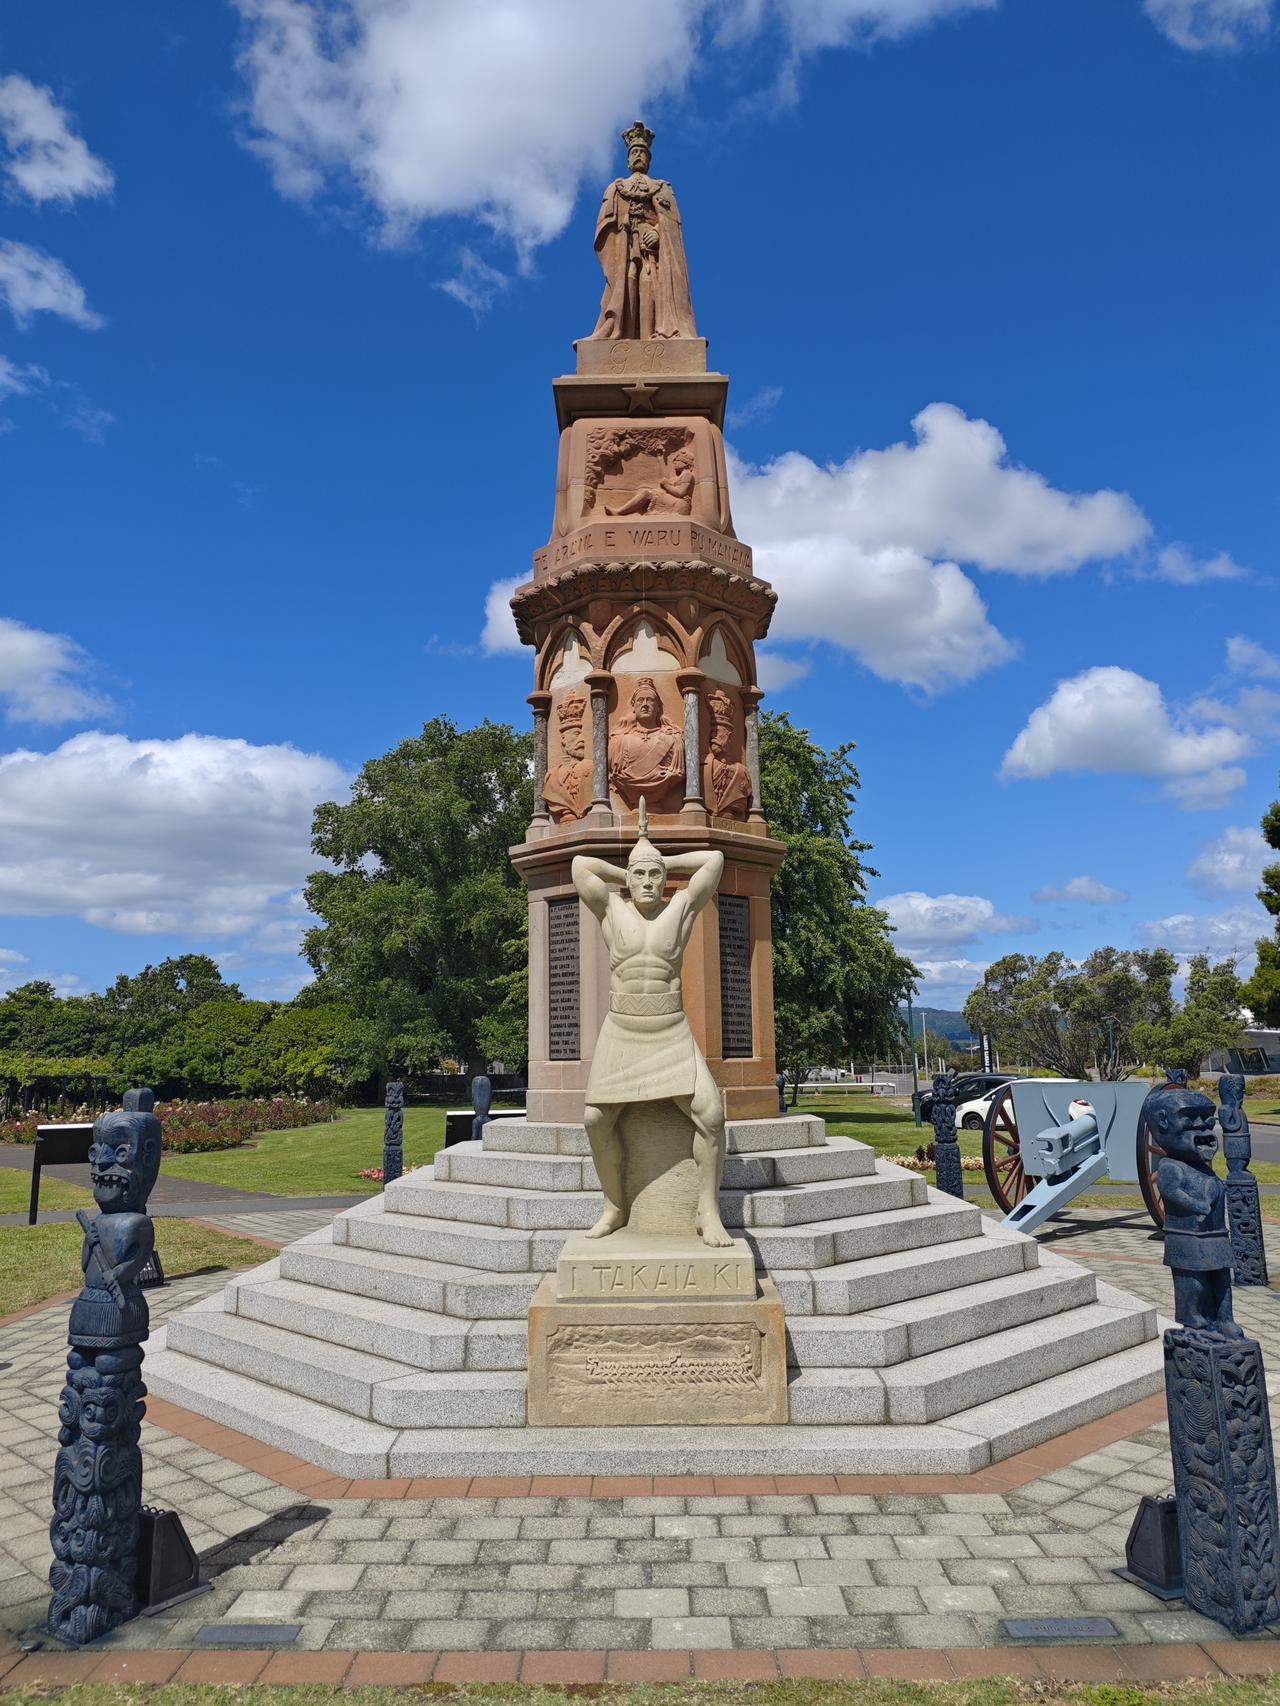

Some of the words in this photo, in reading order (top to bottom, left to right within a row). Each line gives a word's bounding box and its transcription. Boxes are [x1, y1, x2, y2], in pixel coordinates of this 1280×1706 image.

[534, 554, 548, 571] TE
[554, 533, 593, 566] ARAWA
[604, 531, 616, 547] E
[627, 529, 681, 546] WARU
[570, 1265, 578, 1293] I
[592, 1263, 699, 1293] TAKAIA
[712, 1262, 743, 1291] KI
